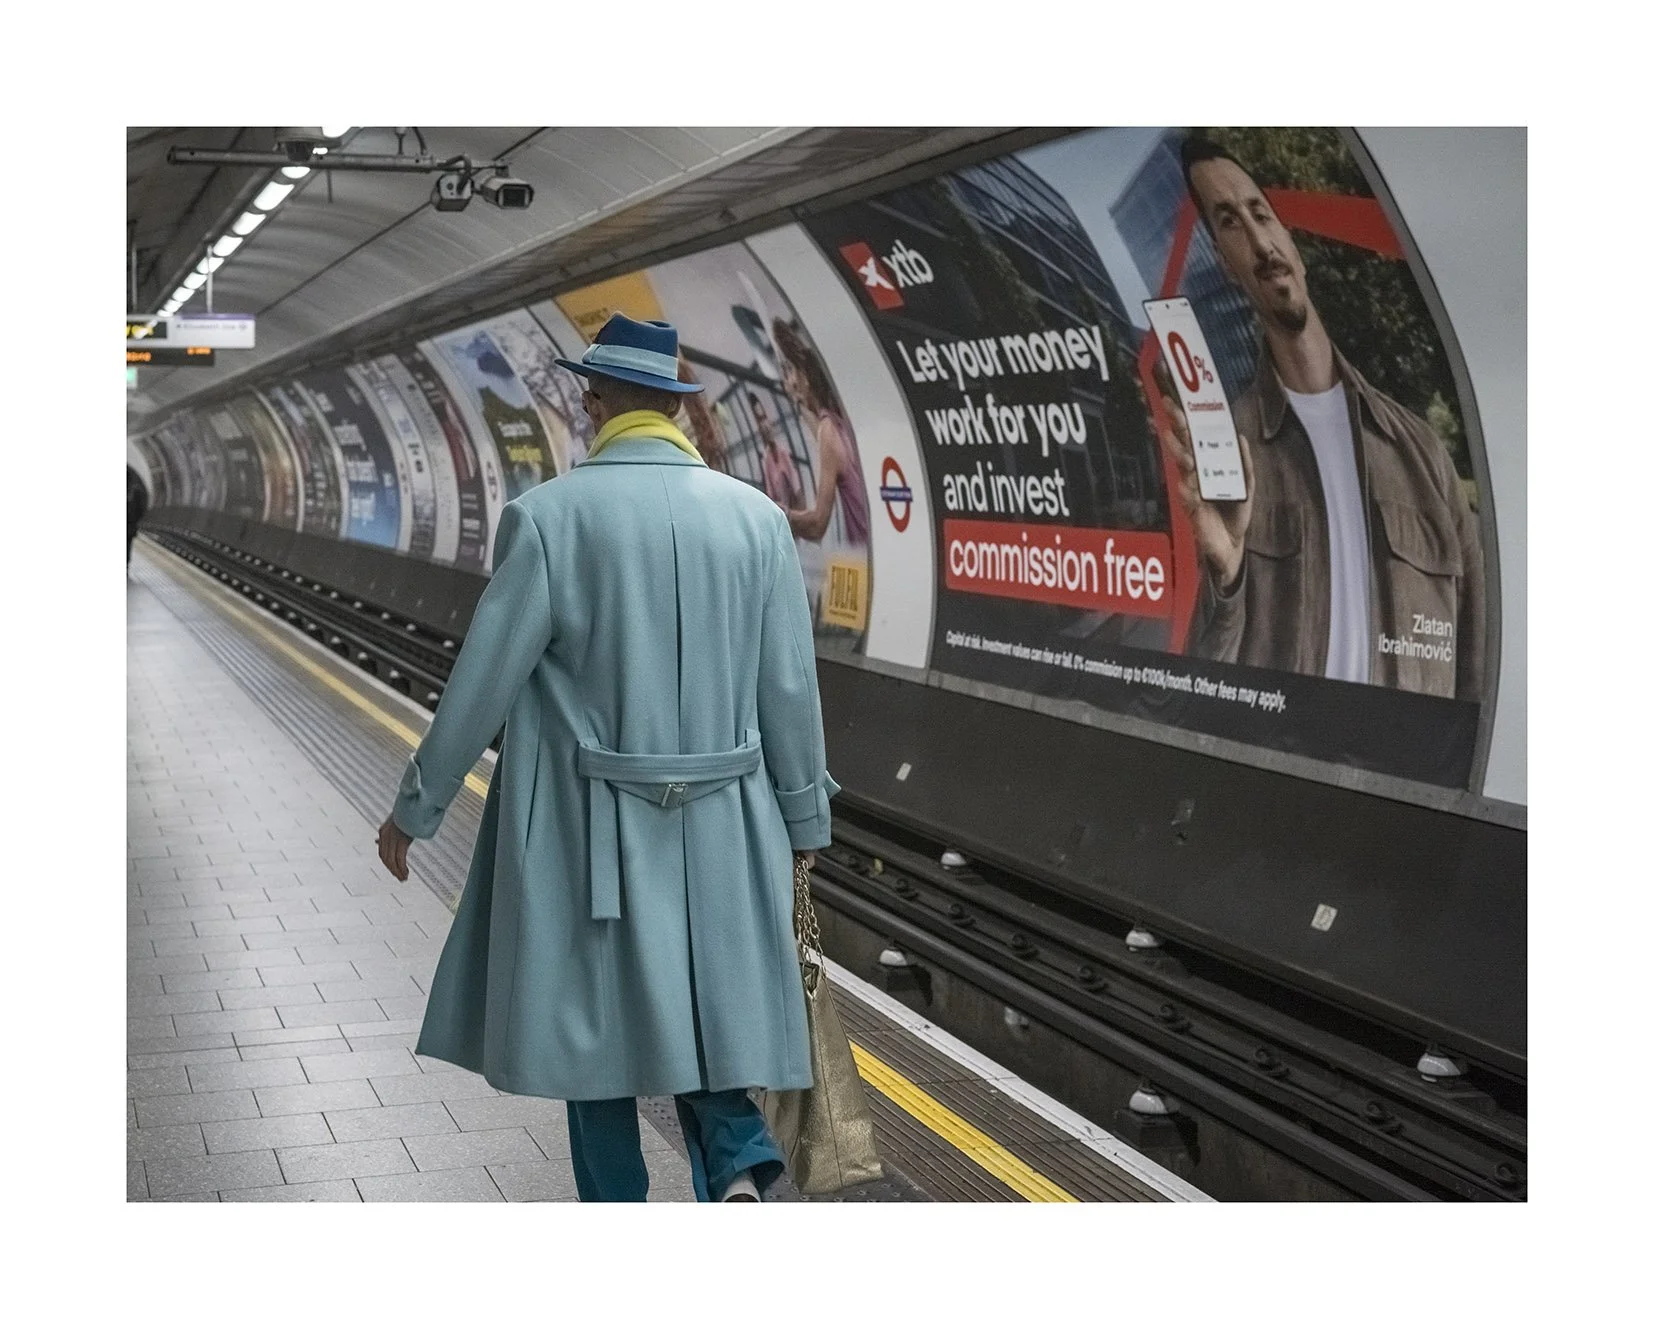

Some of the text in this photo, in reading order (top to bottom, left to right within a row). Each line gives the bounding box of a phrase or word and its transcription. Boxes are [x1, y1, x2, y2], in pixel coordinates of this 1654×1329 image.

[882, 239, 934, 287] xtb
[897, 325, 1109, 391] Let your money
[1167, 331, 1214, 393] 0%
[925, 394, 1087, 457] work for you
[943, 460, 1070, 517] and invest
[949, 531, 1165, 601] commission free
[1378, 632, 1452, 662] Ibrahimović
[1412, 613, 1453, 637] Zlatan
[946, 630, 964, 648] Capital
[1084, 659, 1123, 679] commission
[1123, 667, 1133, 685] up
[1133, 667, 1141, 683] to
[1194, 677, 1218, 697] Other
[1218, 680, 1238, 701] fees
[1238, 687, 1259, 708] may
[1259, 690, 1286, 713] apply.
